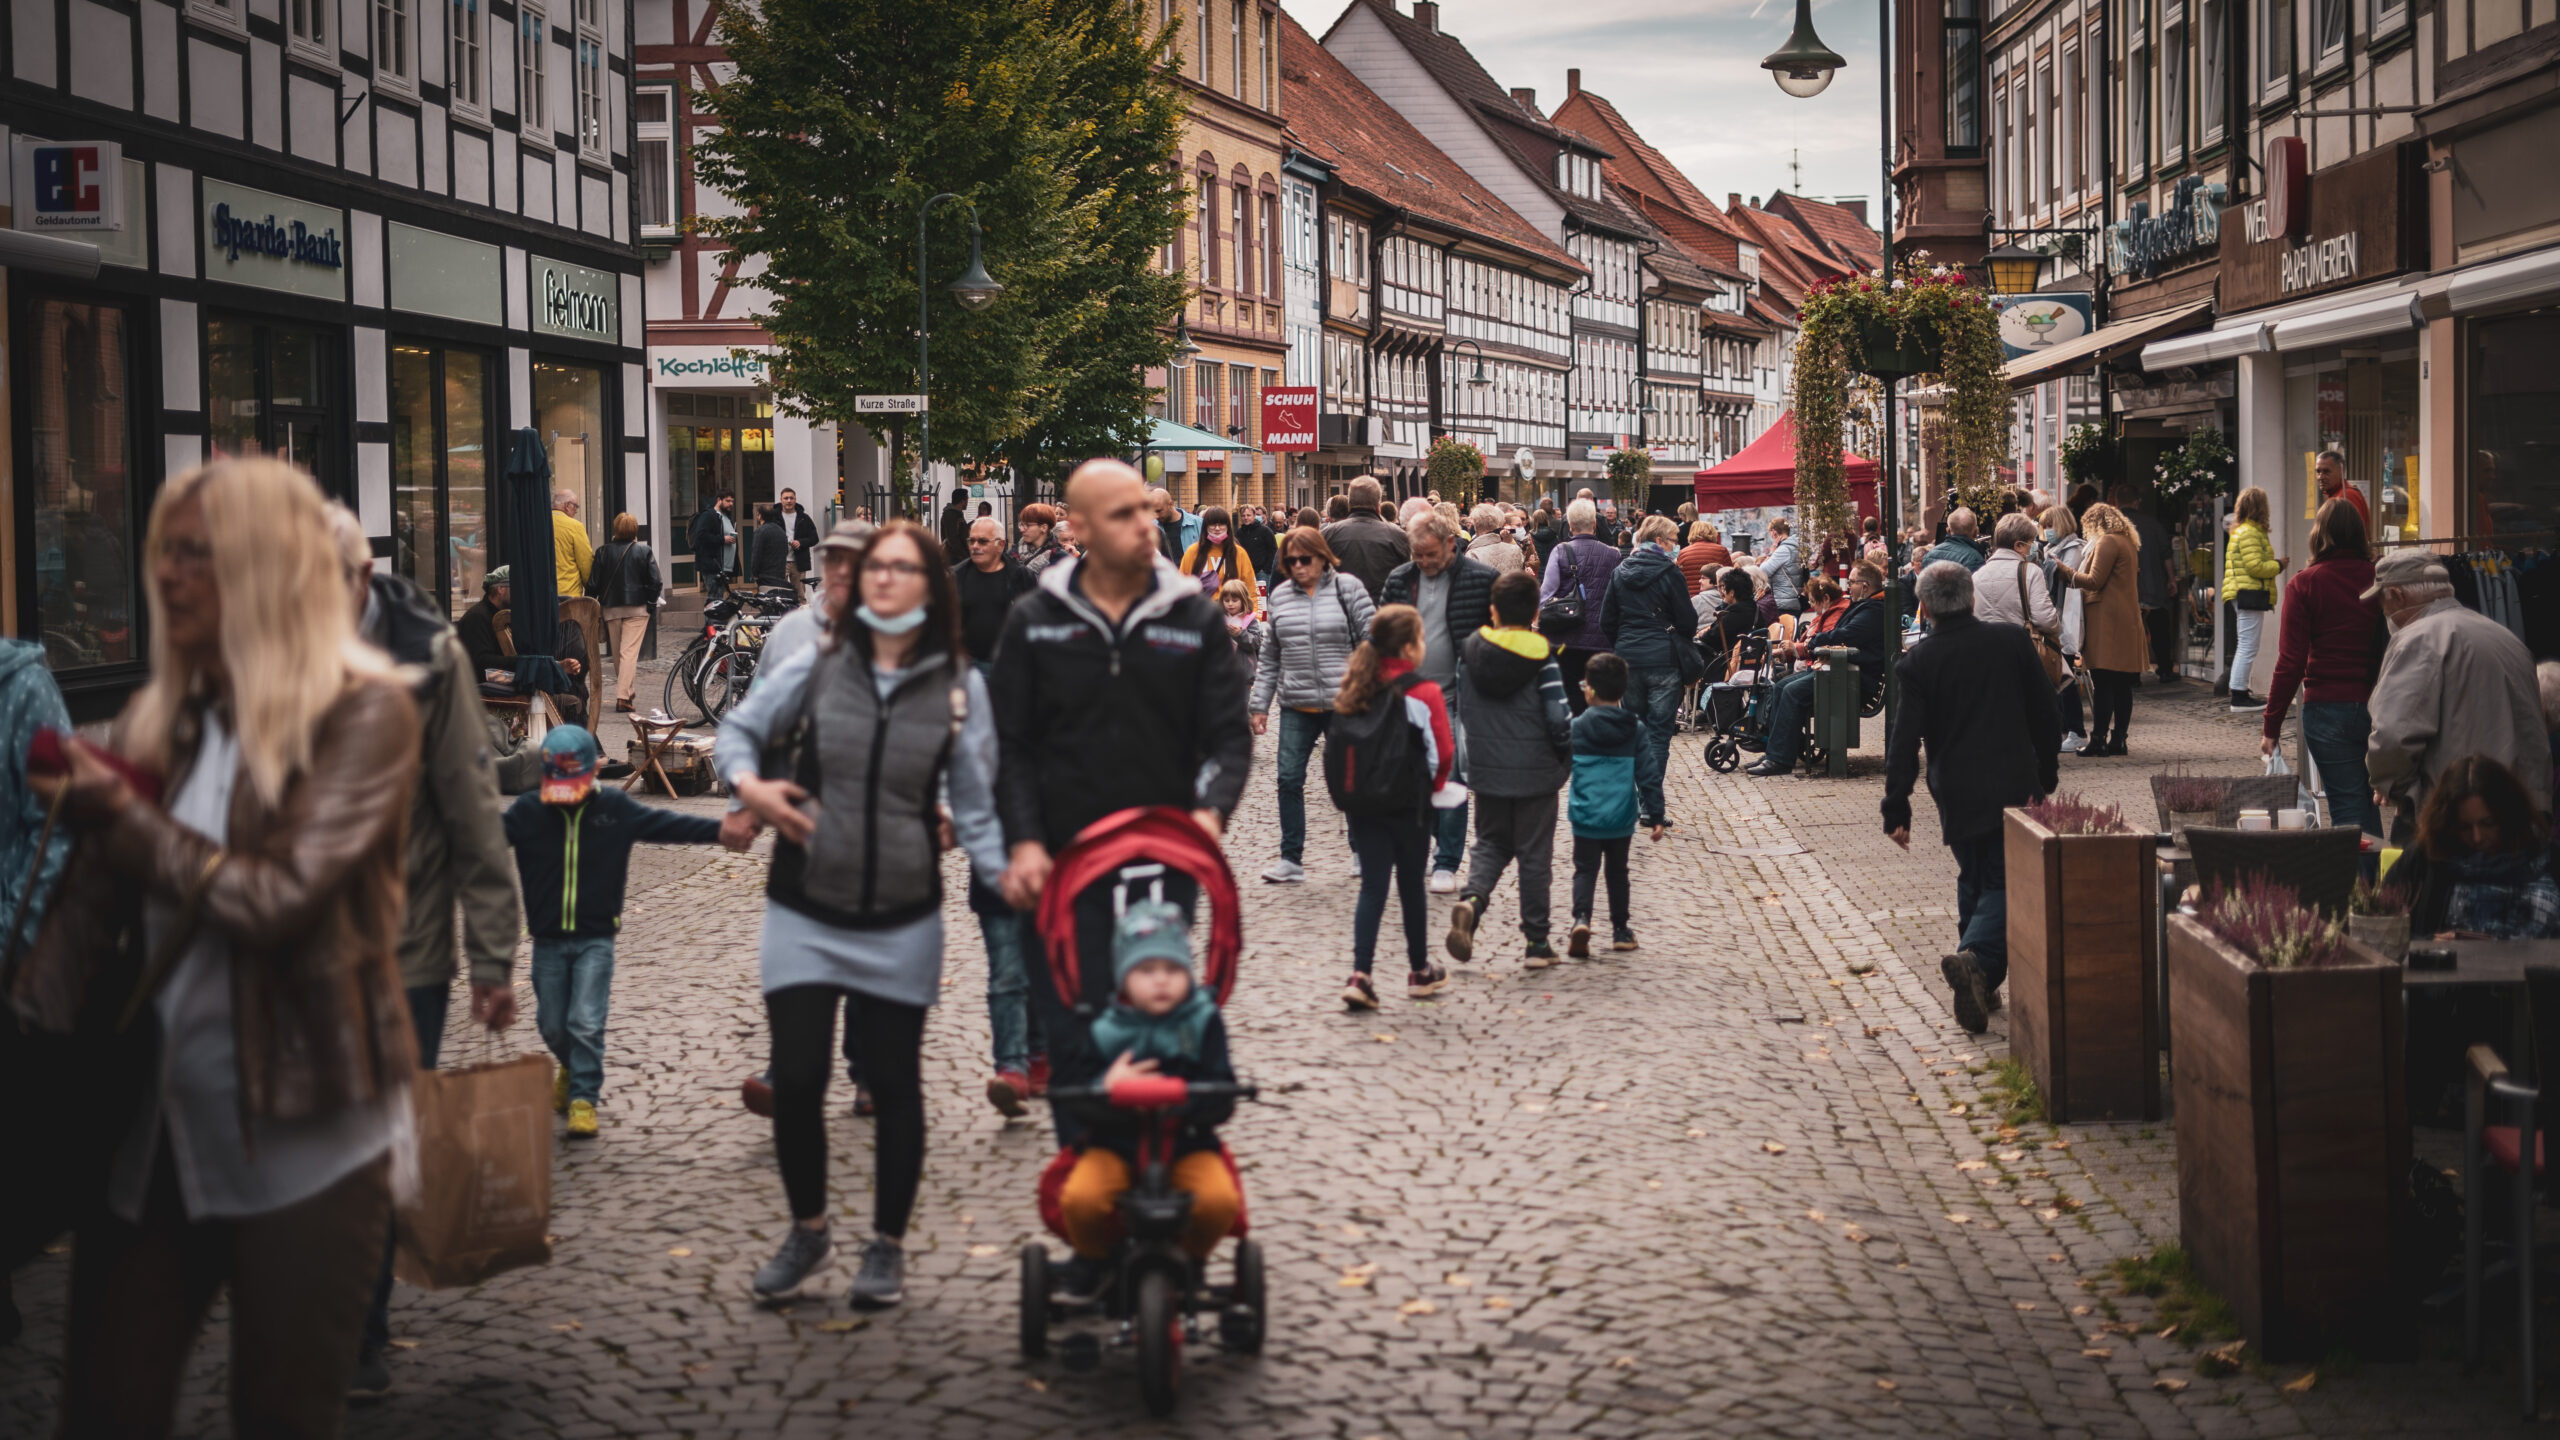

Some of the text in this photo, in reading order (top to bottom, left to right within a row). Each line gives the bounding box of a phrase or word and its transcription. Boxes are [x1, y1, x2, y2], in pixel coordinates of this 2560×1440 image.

[35, 215, 101, 226] Geldautomat
[2243, 199, 2271, 245] WEB
[213, 202, 343, 269] Sparda-Bank
[2281, 231, 2359, 293] PARFÜMERIEN
[543, 268, 609, 334] fielmann
[657, 356, 764, 378] Kochlöffel
[860, 398, 916, 409] Kurze Straße
[1265, 394, 1315, 406] SCHUH
[1266, 432, 1314, 445] MANN
